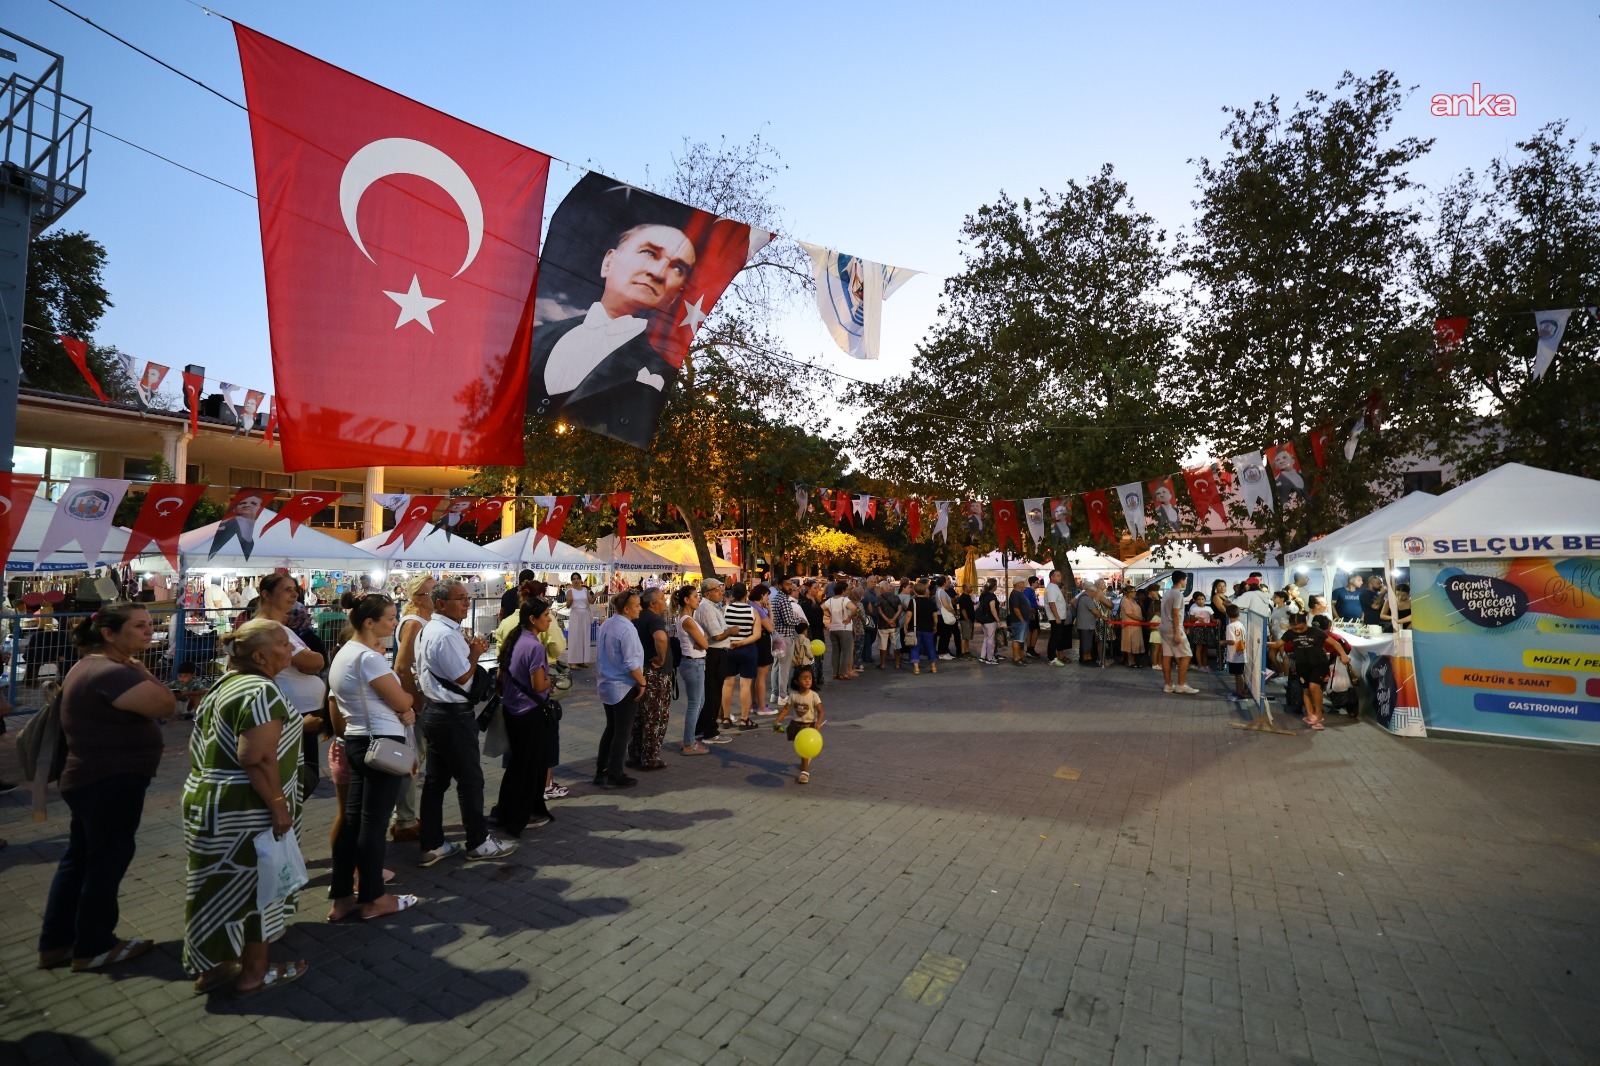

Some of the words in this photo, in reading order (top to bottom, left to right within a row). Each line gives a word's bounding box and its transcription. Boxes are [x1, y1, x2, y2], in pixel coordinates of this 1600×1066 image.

[1433, 536, 1554, 555] SELÇUK
[406, 562, 446, 570] SELÇUK
[449, 562, 501, 570] BELEDİYESİ
[562, 563, 600, 571] BELEDİYESİ
[1451, 578, 1492, 591] Geçmişi
[1462, 589, 1499, 600] hisset,
[1467, 594, 1517, 610] geleceği
[1480, 606, 1516, 619] keşfet
[1533, 655, 1571, 666] MÜZİK
[1574, 657, 1581, 667] /
[1584, 659, 1600, 668] PE
[1463, 673, 1505, 685] KÜLTÜR
[1507, 677, 1515, 685] &
[1518, 678, 1552, 688] SANAT
[1508, 701, 1579, 715] GASTRONOMİ
